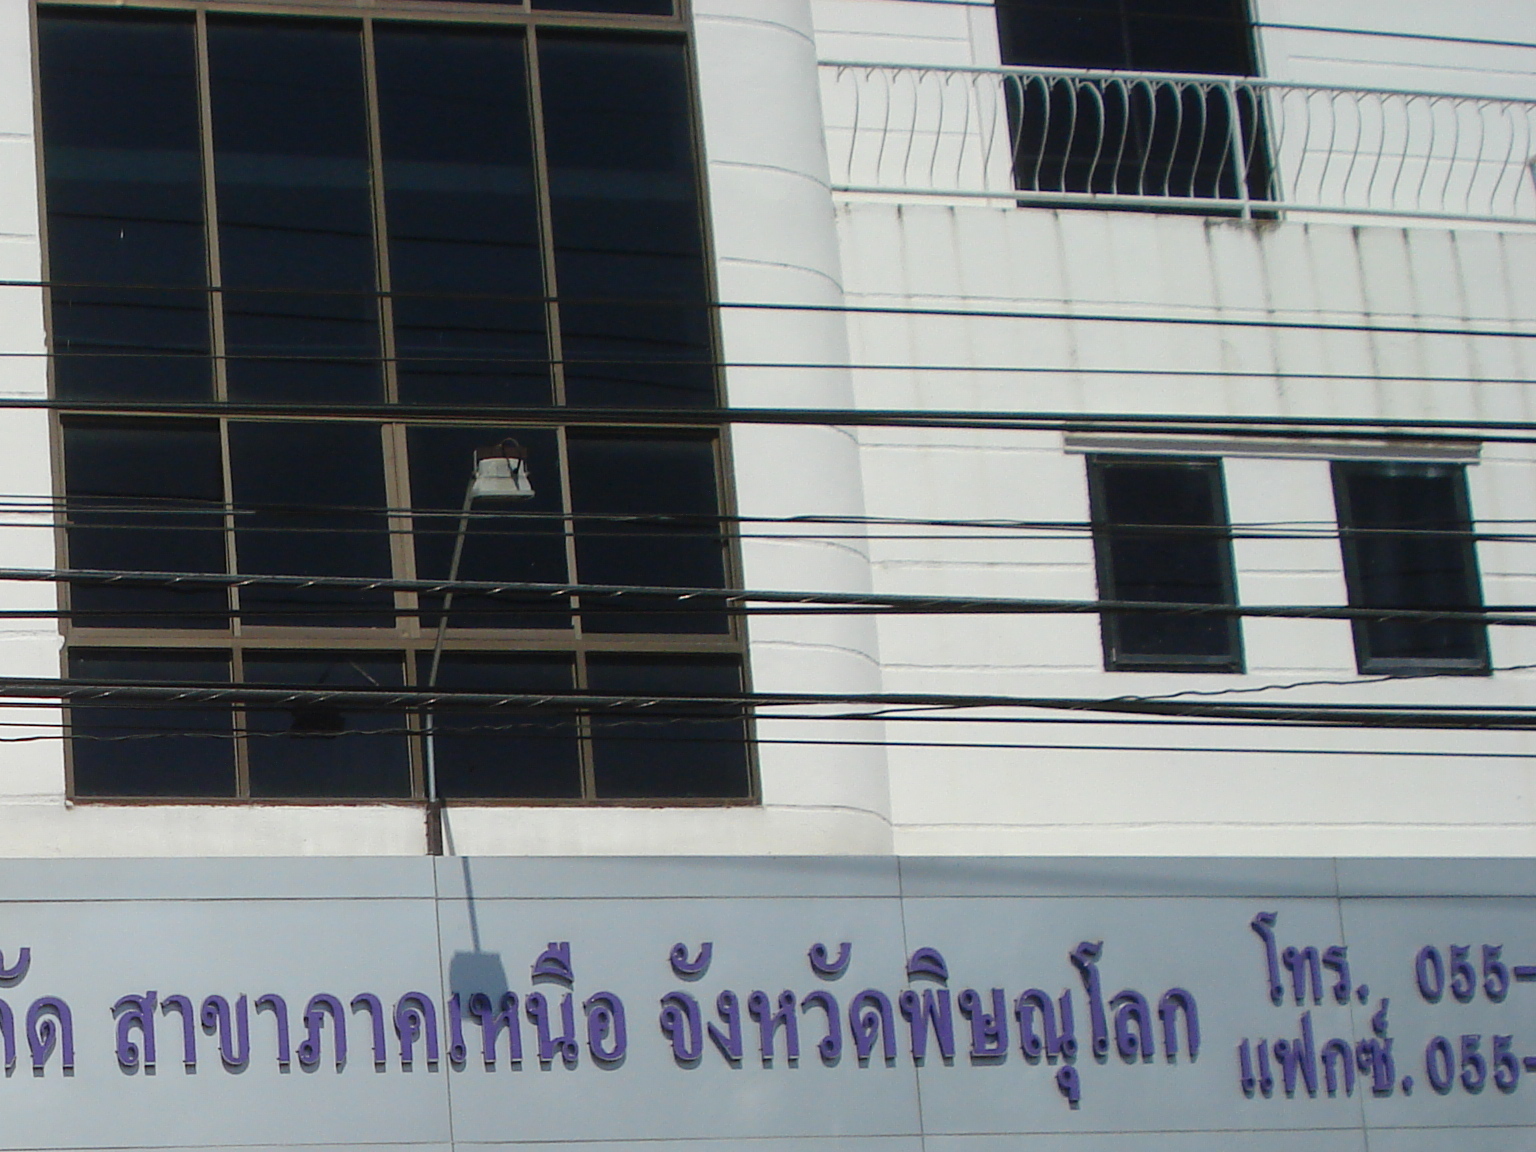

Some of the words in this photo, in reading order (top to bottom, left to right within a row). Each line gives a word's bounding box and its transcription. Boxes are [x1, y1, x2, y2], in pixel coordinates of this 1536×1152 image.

[1251, 911, 1369, 1001] โทร.
[112, 941, 629, 1065] สาขาภาคเหนือ
[660, 941, 1202, 1102] จังหวัดพิษณุโลก
